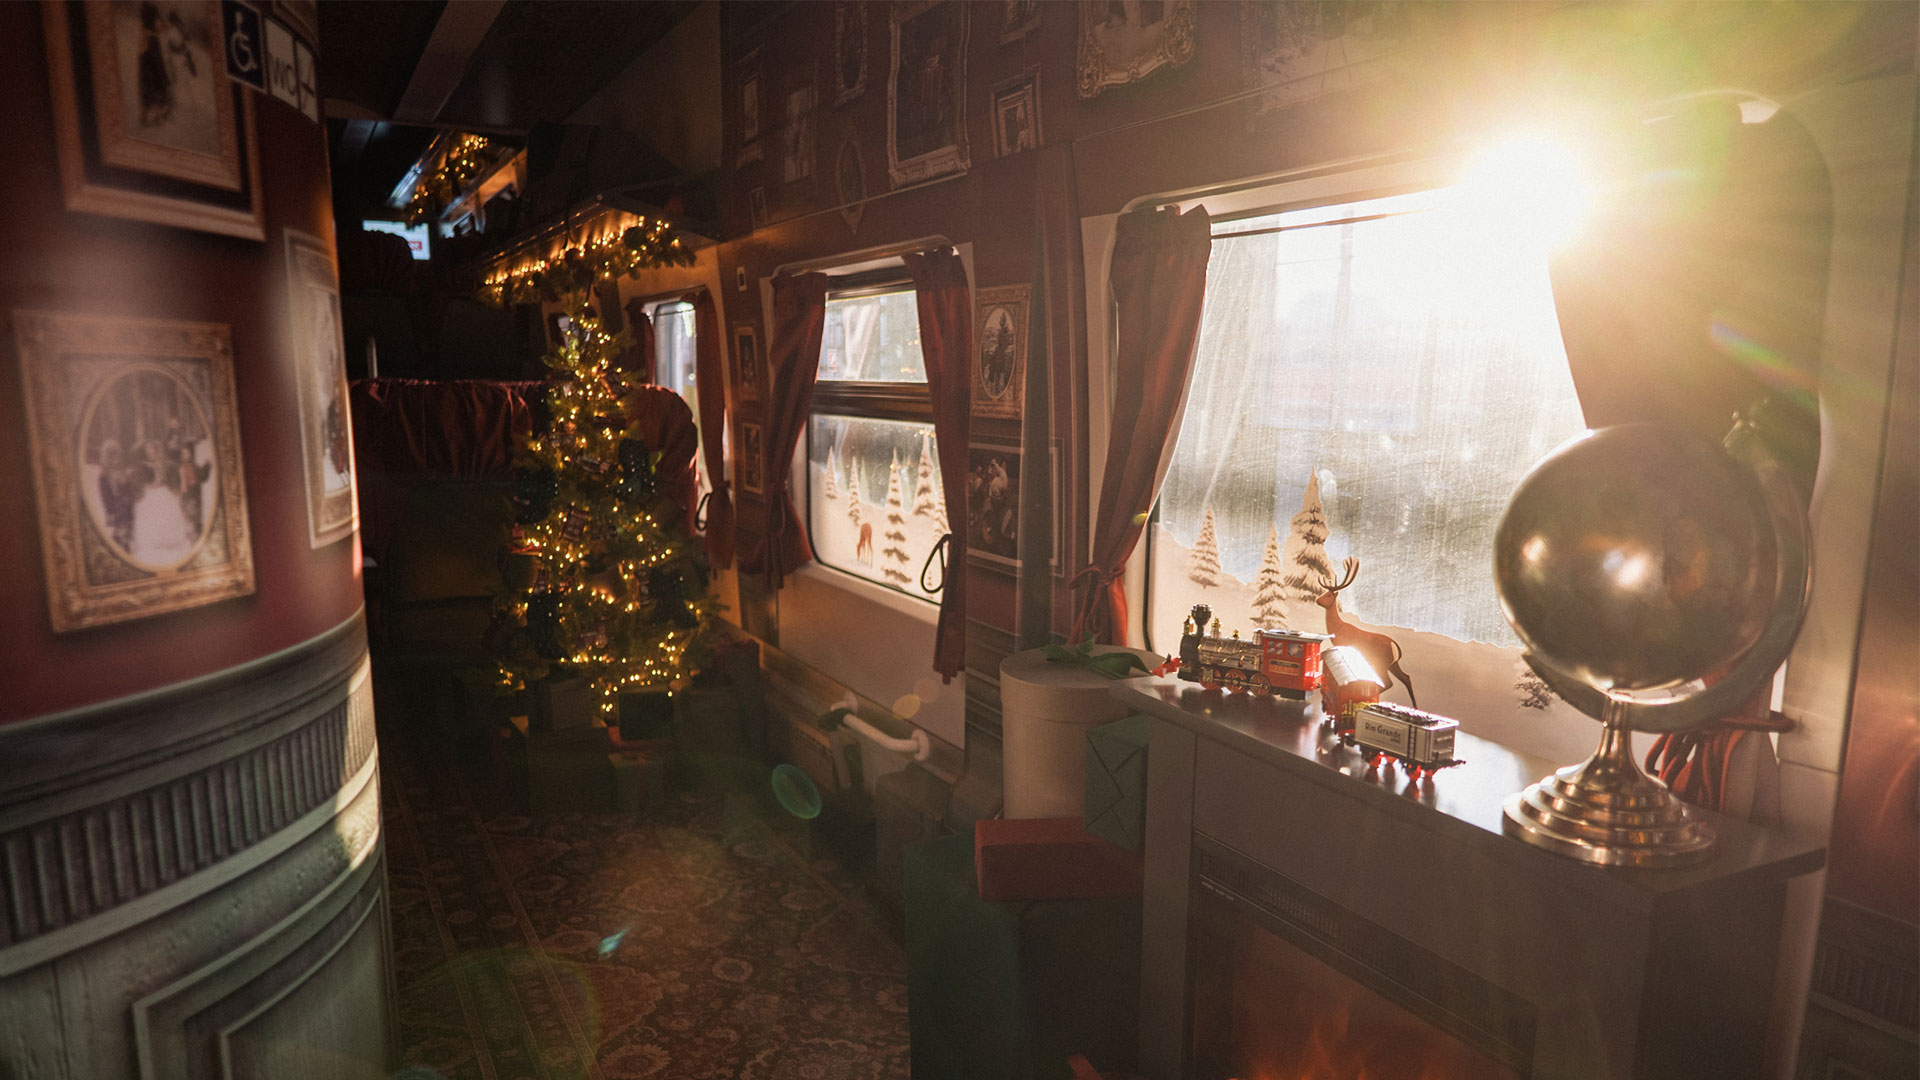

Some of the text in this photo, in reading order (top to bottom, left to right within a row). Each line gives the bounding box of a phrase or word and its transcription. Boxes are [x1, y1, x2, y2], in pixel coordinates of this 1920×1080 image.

[269, 52, 295, 96] WC
[1365, 722, 1401, 738] Rio Grande
